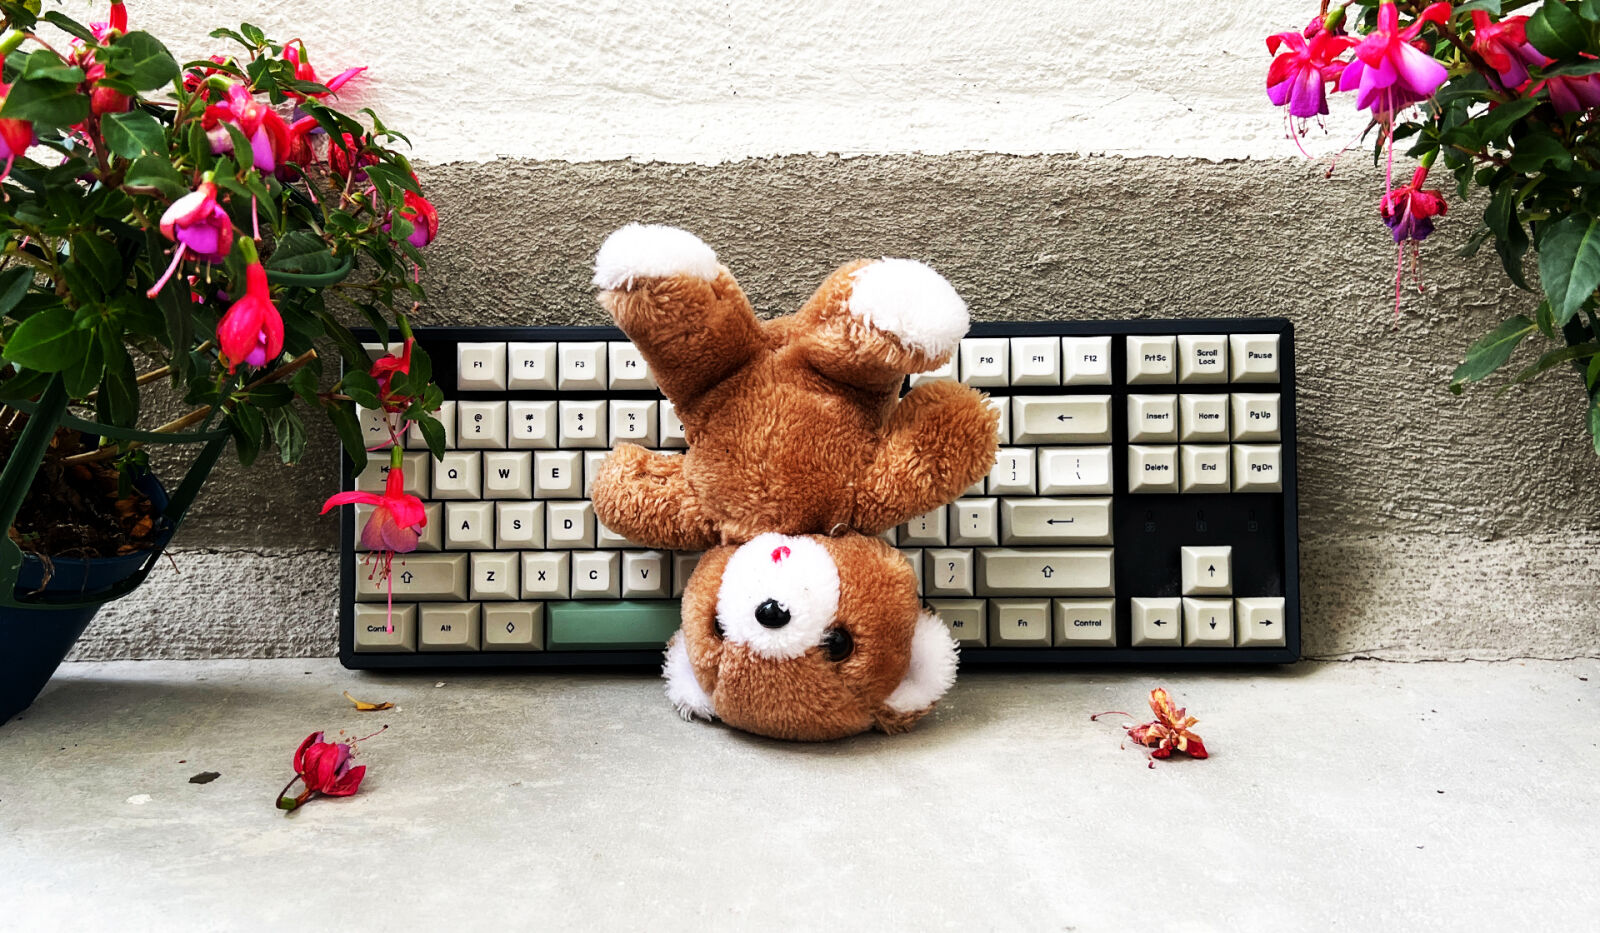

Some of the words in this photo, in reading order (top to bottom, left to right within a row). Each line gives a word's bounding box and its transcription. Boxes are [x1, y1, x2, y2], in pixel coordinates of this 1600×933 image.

[1196, 348, 1218, 357] Scroll
[1248, 351, 1273, 359] Pause
[980, 356, 994, 364] F10
[1032, 355, 1044, 363] F11
[1083, 354, 1097, 362] F12
[524, 360, 535, 368] F2
[625, 360, 636, 368] F4
[474, 413, 483, 423] @
[525, 413, 534, 421] #
[577, 412, 584, 422] $
[627, 413, 636, 421] %
[1146, 412, 1169, 420] Insert
[1198, 412, 1220, 420] Home
[475, 425, 481, 433] 2
[527, 425, 533, 433] 3
[577, 424, 584, 432] 4
[629, 424, 635, 432] 5
[1144, 463, 1169, 472] Delete
[1201, 463, 1217, 471] End
[447, 468, 458, 479] Q
[498, 468, 510, 479] W
[551, 467, 560, 479] E
[461, 520, 470, 531] A
[513, 519, 522, 530] S
[563, 518, 573, 530] D
[948, 562, 955, 571] ?
[486, 570, 495, 582] Z
[537, 570, 546, 582] X
[589, 569, 598, 580] C
[640, 568, 649, 579] V
[952, 620, 964, 628] Alt
[1017, 618, 1028, 627] Fn
[1073, 619, 1102, 627] Control
[440, 624, 452, 632] Alt
